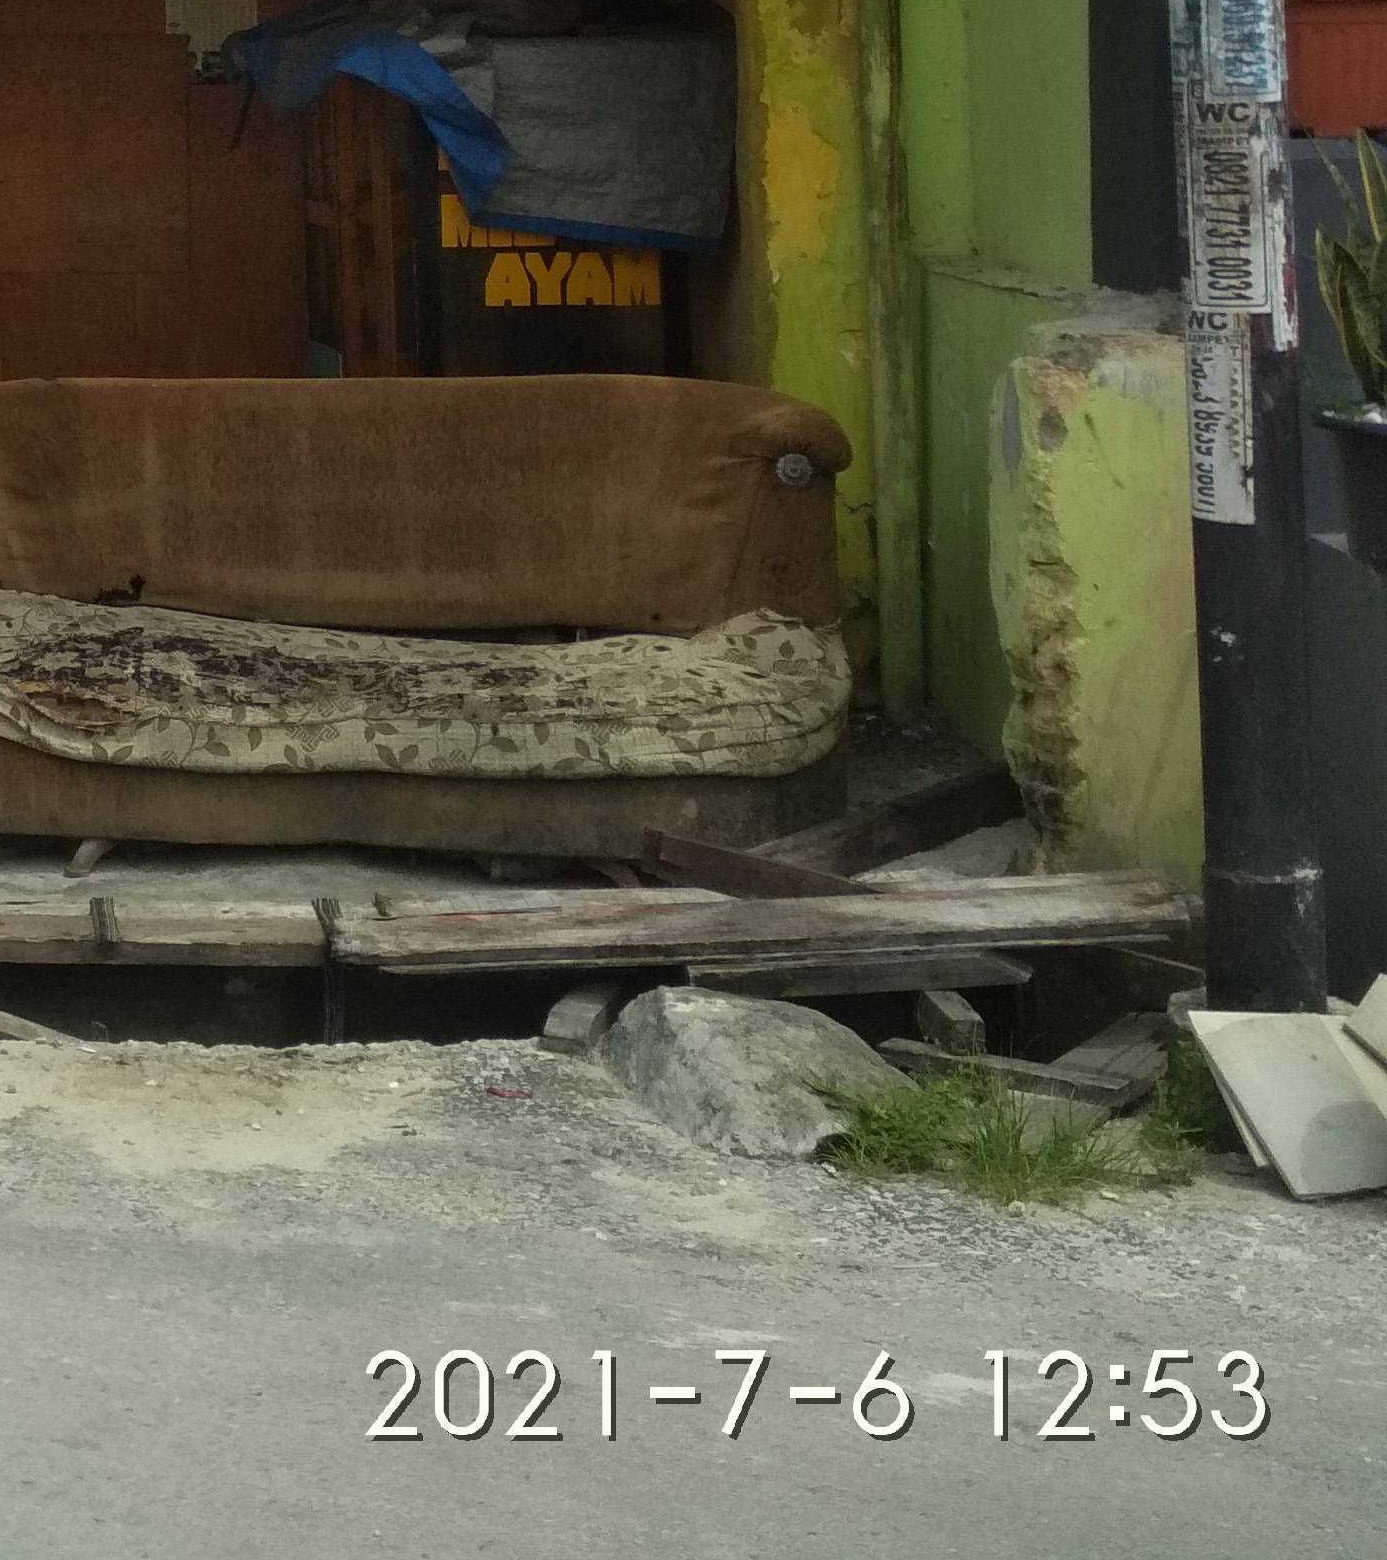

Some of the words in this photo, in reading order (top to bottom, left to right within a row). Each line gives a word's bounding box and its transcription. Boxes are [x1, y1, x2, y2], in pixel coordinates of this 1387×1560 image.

[1196, 101, 1251, 123] WC
[1204, 150, 1251, 196] 0821
[1205, 202, 1252, 249] 7731
[484, 251, 661, 307] AYAM
[1207, 256, 1255, 302] 0031
